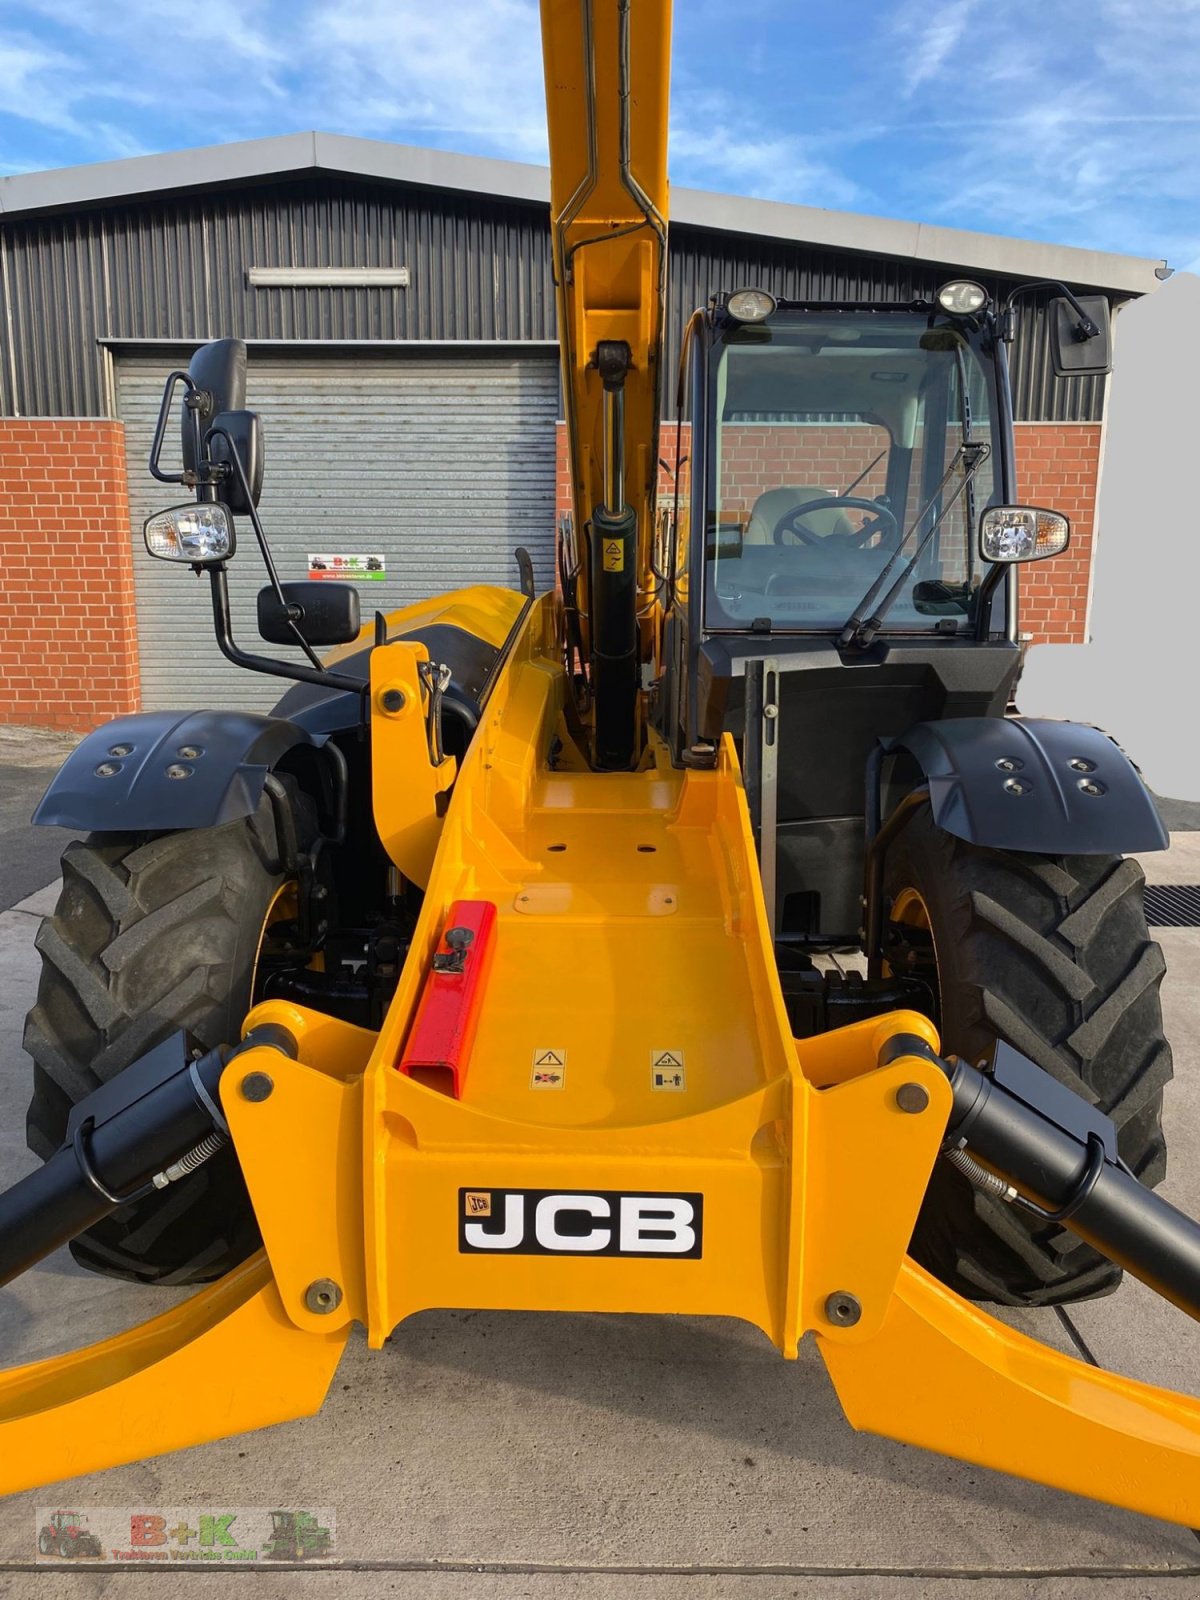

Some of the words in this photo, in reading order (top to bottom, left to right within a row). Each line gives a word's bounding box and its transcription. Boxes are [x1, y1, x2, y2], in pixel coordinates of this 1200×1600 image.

[334, 557, 359, 566] B+K
[471, 1197, 488, 1211] JCB
[465, 1194, 696, 1253] JCB
